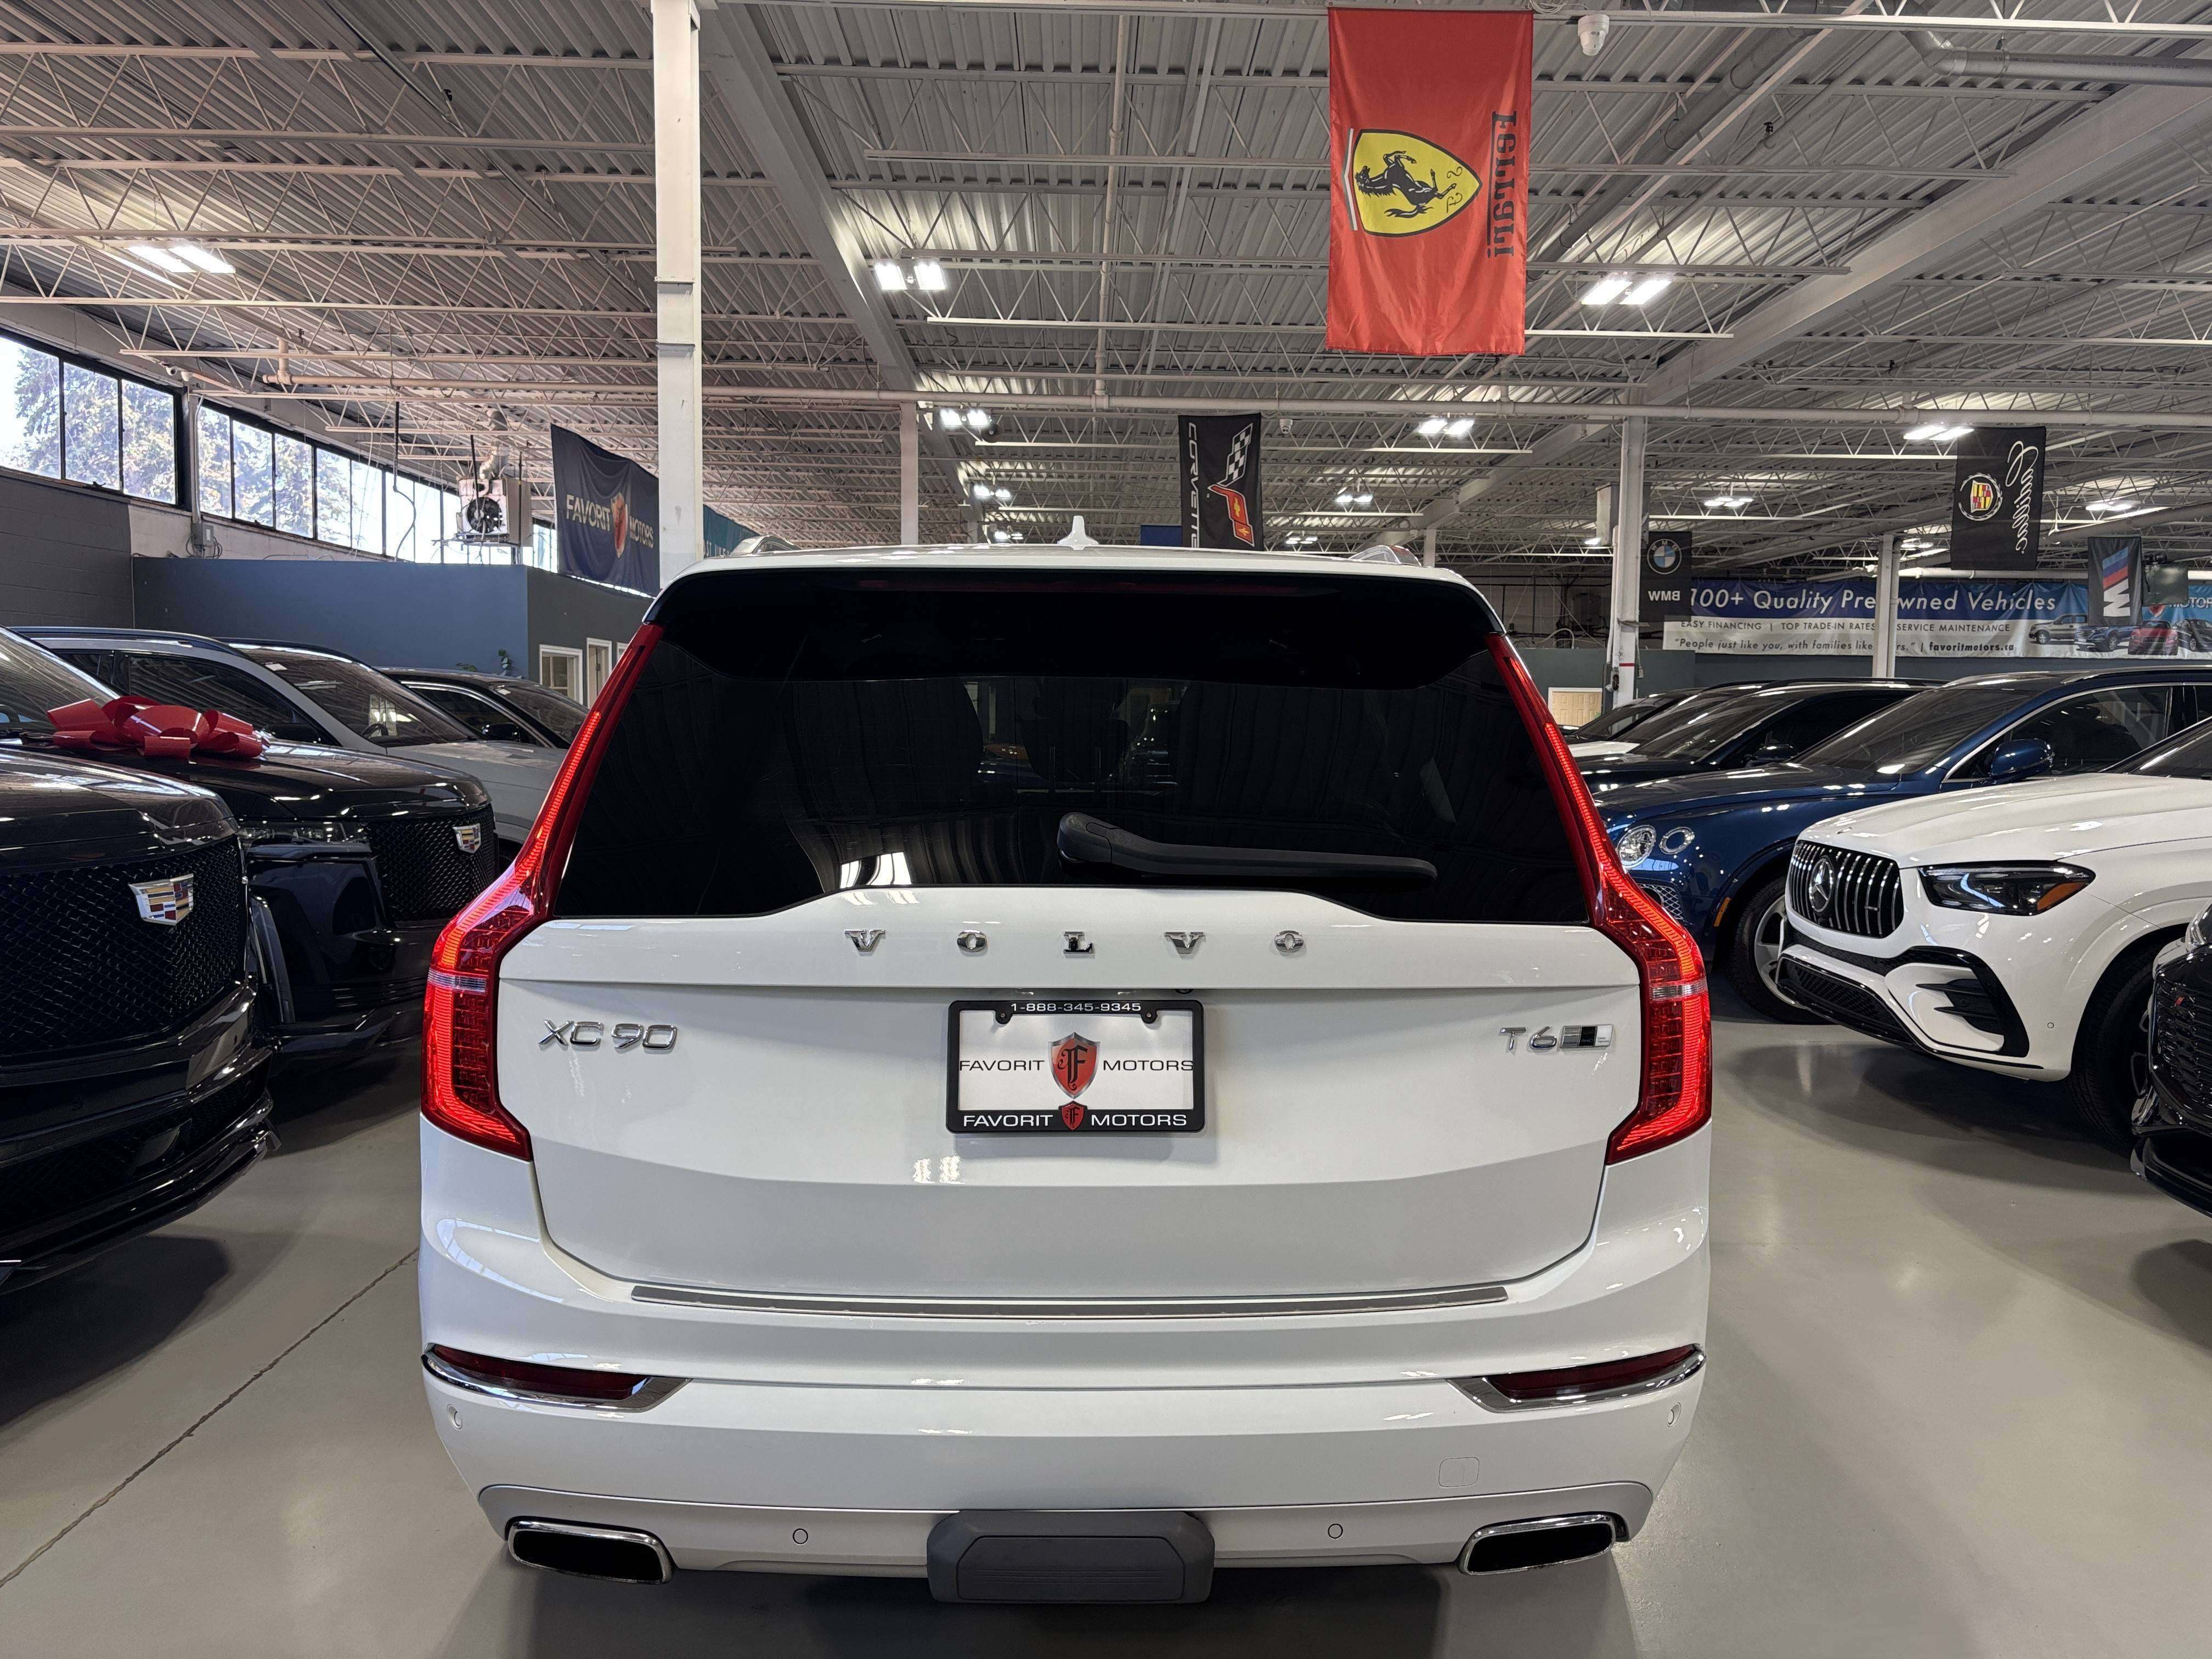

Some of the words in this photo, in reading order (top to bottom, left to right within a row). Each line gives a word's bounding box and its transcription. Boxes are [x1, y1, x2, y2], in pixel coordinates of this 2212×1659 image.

[1188, 422, 1200, 548] CORVETTE
[566, 494, 611, 532] FAVORIT
[630, 516, 654, 549] MOTORS
[1753, 589, 1833, 614] Quality
[1898, 590, 1959, 610] wned
[1968, 590, 2056, 611] Vehicles
[1708, 621, 1762, 630] FINANCING
[1803, 622, 1845, 630] TRADE-IN
[1718, 639, 1736, 649] just
[1740, 639, 1758, 649] like
[1762, 642, 1783, 651] you,
[1788, 640, 1808, 649] with
[1812, 640, 1852, 650] families
[1856, 640, 1873, 650] like
[1929, 642, 2015, 651] favoritmotors.ca
[844, 929, 1305, 954] VOLVO
[1011, 1002, 1141, 1012] 1-888-345-9345
[1500, 1026, 1558, 1049] T6
[960, 1060, 1045, 1071] FAVORIT
[1103, 1059, 1193, 1071] MOTORS
[963, 1114, 1053, 1127] FAVORIT
[1091, 1114, 1187, 1126] MOTORS
